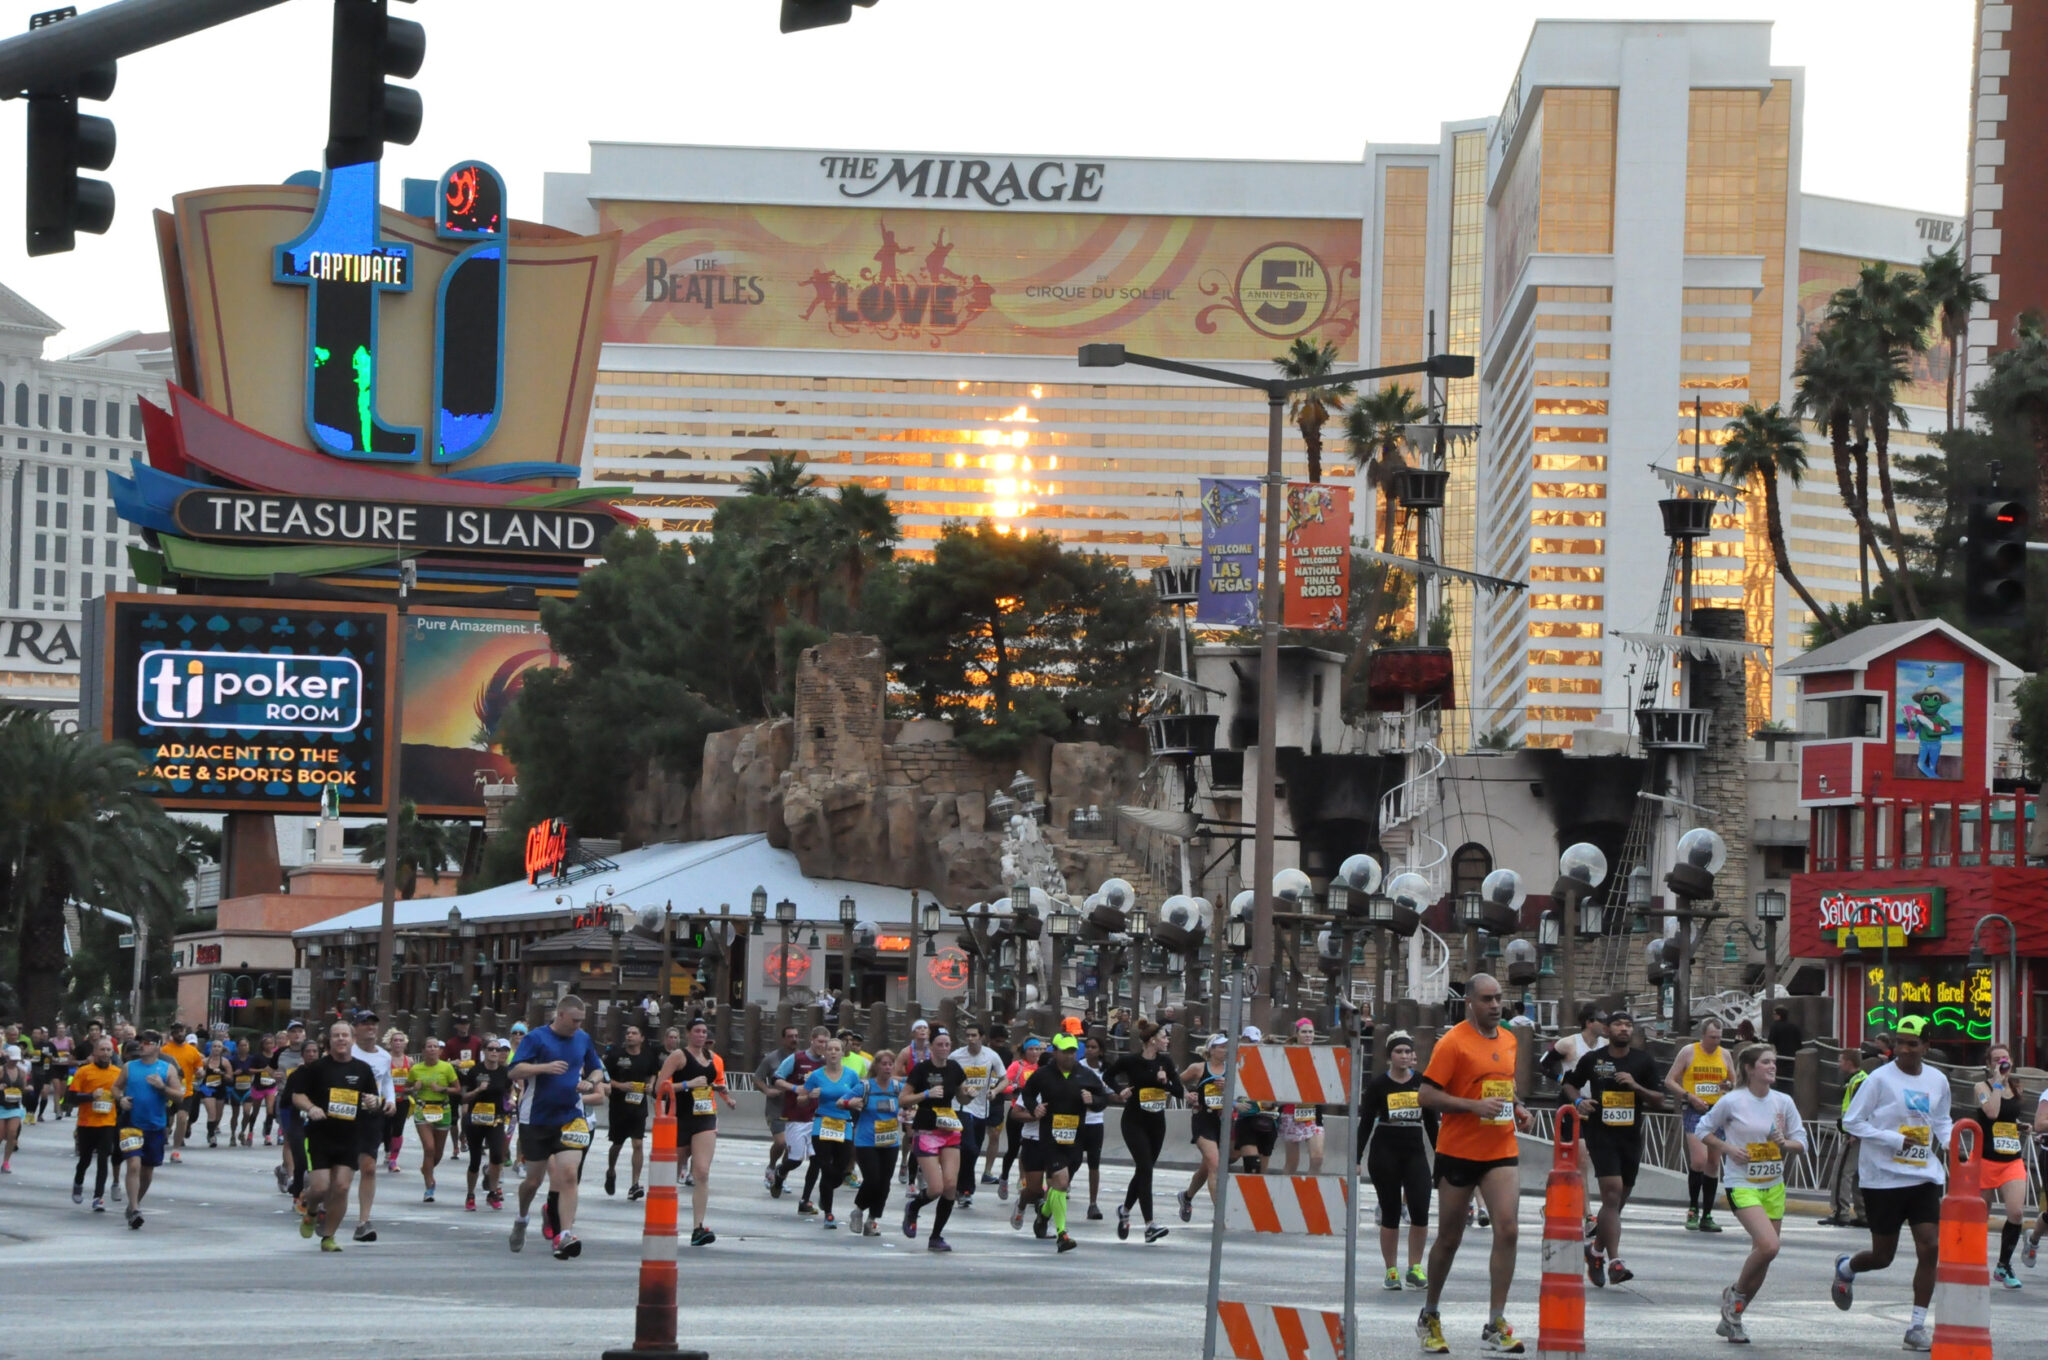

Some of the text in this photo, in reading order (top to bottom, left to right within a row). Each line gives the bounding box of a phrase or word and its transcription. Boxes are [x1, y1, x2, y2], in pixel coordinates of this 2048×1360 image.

[820, 156, 1106, 206] THE MIRAGE
[1915, 217, 1955, 243] THE
[309, 251, 402, 284] CAPTIVATE
[694, 258, 718, 271] THE
[645, 257, 765, 309] BEATLES
[1096, 274, 1109, 283] BY
[1025, 286, 1175, 302] CIRQUE DU SOLEIL
[1247, 289, 1319, 300] ANNIVERSARY
[836, 282, 958, 326] LOVE
[207, 497, 595, 549] TREASURE ISLAND
[1208, 544, 1252, 555] WELCOME
[1291, 546, 1342, 557] LAS VEGAS
[1299, 557, 1337, 565] WELCOMES
[1212, 562, 1241, 578] LAS
[1294, 565, 1342, 576] NATIONAL
[1209, 578, 1253, 593] VEGAS
[1304, 576, 1336, 585] FINALS
[1300, 585, 1342, 598] RODEO
[417, 618, 446, 630] Pure
[450, 619, 530, 634] Amazement.
[0, 620, 80, 665] RA
[150, 658, 350, 719] ti poker
[266, 703, 339, 721] ROOM
[156, 744, 339, 763] ADJACENT TO THE
[138, 765, 356, 785] ACE & SPORTS BOOK
[1937, 980, 1965, 1003] Here!
[1603, 1110, 1633, 1120] 56301
[1749, 1163, 1782, 1177] 57285
